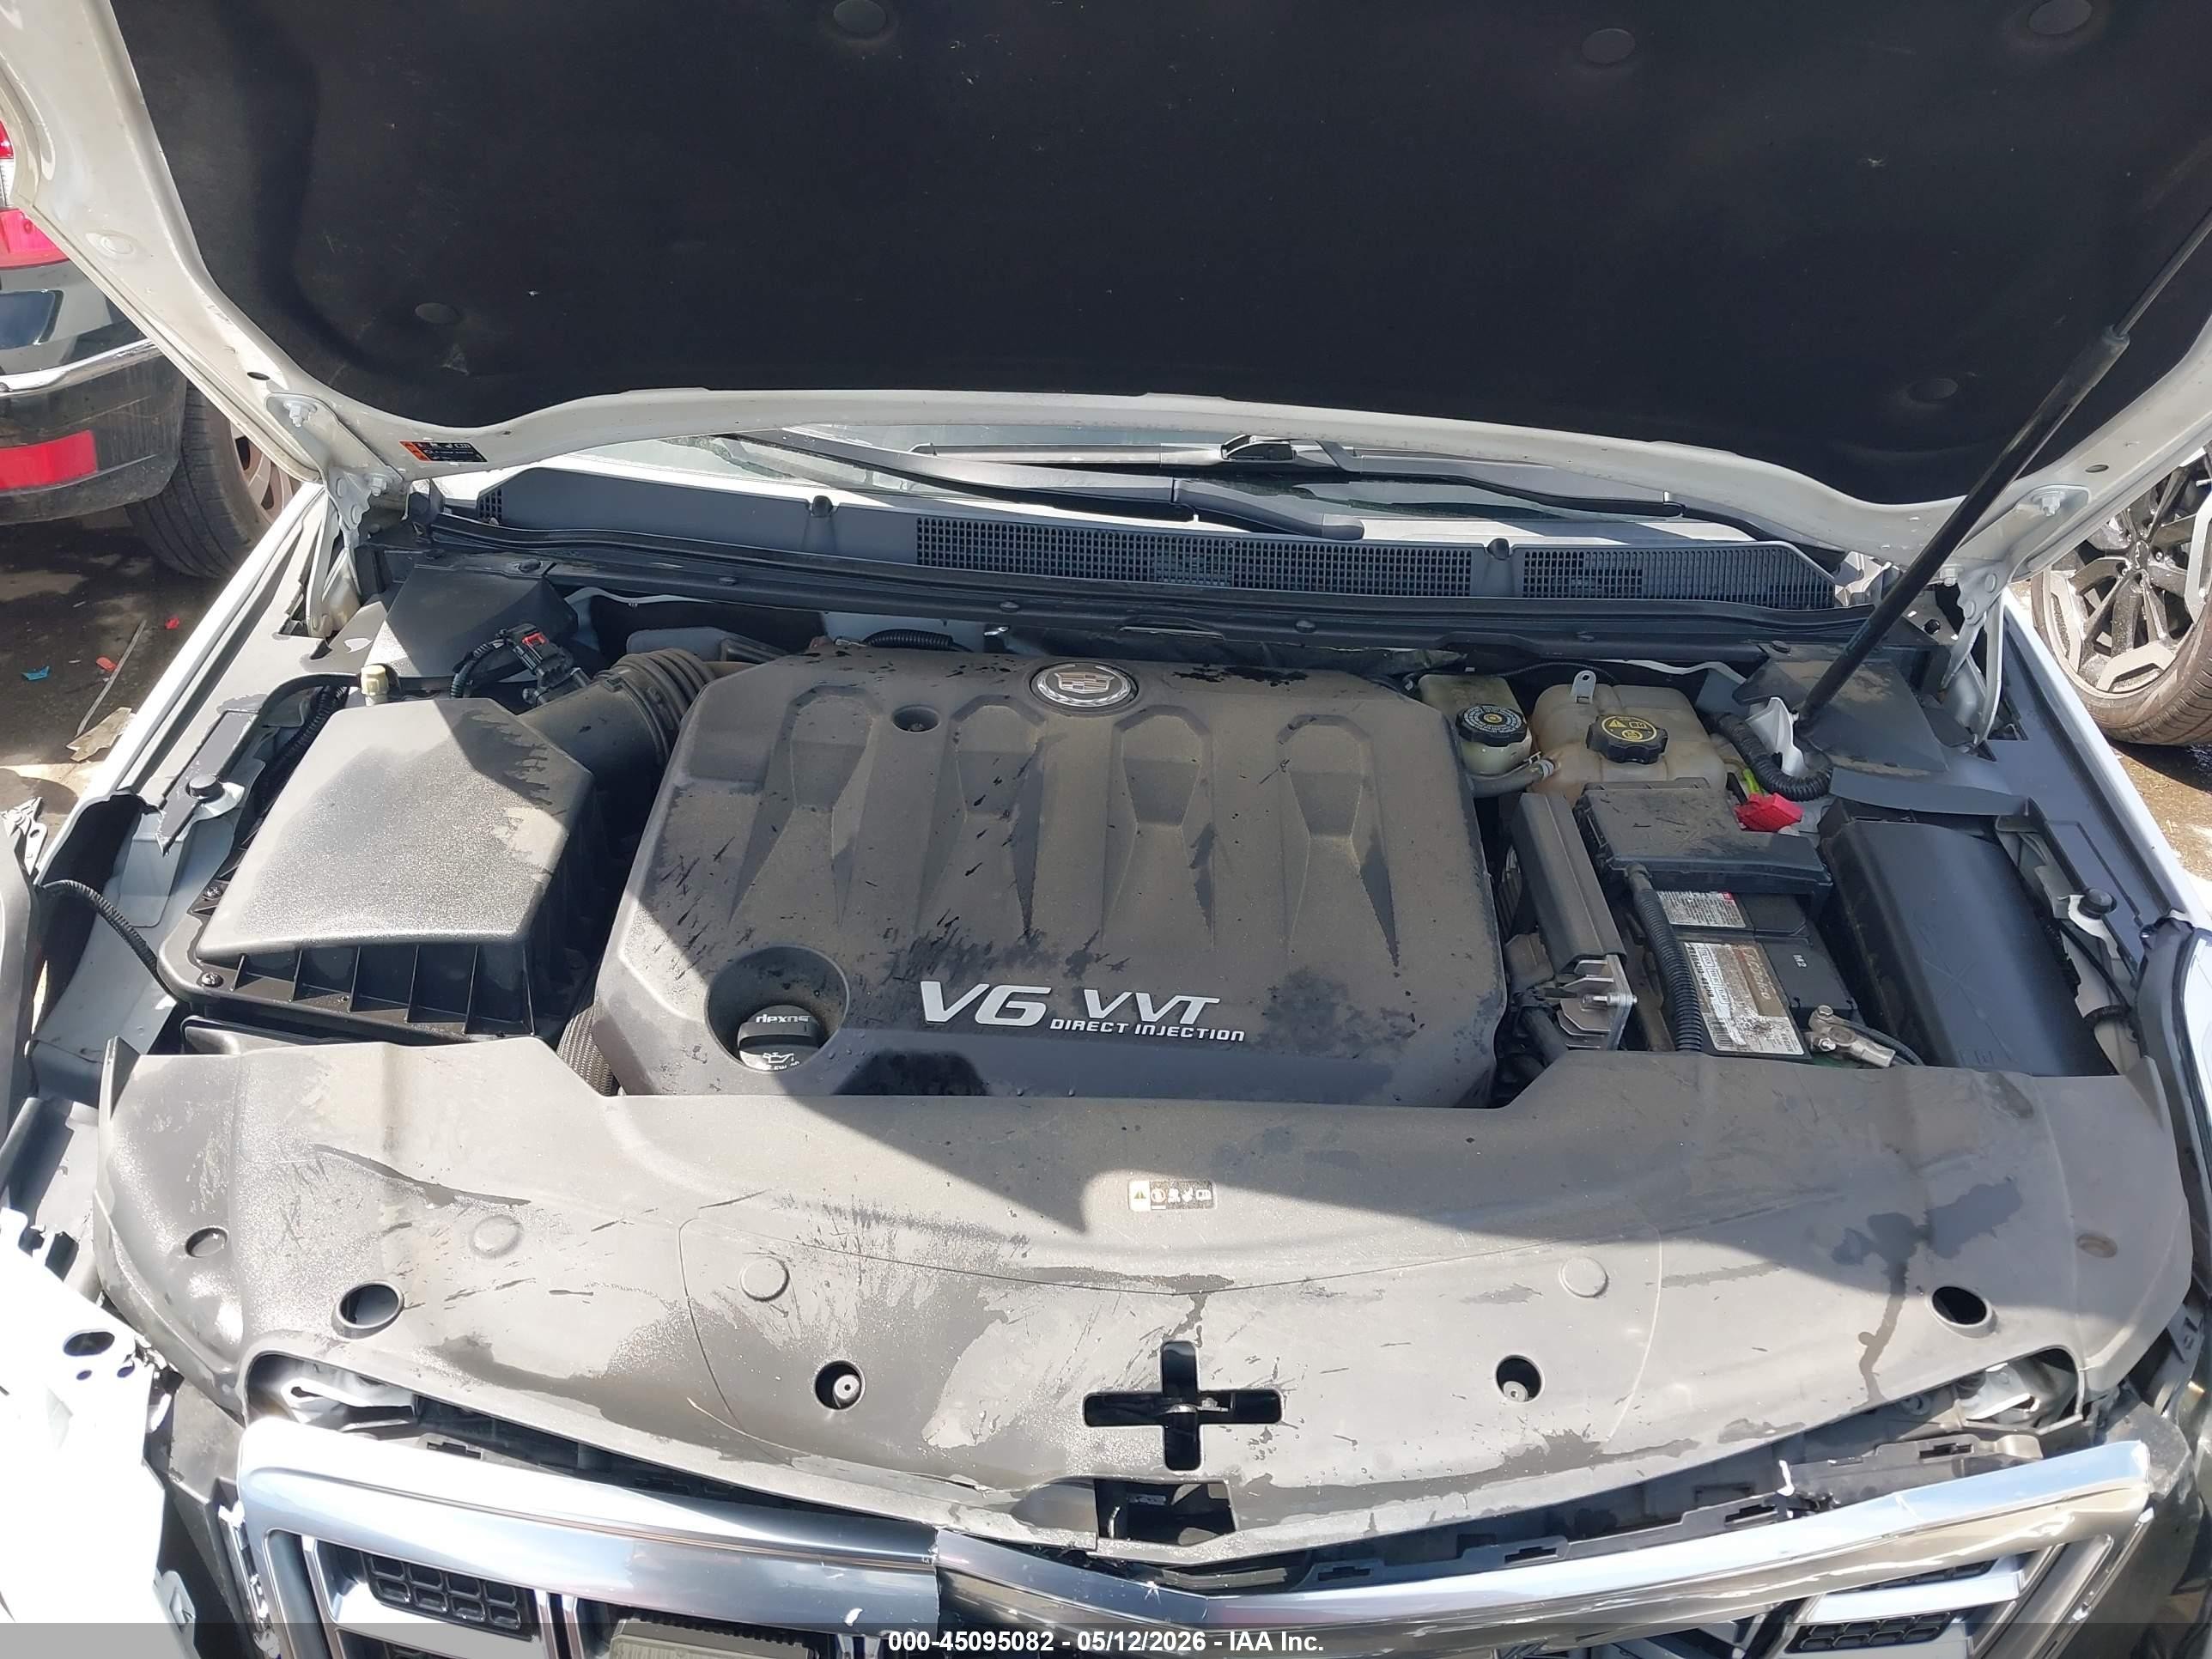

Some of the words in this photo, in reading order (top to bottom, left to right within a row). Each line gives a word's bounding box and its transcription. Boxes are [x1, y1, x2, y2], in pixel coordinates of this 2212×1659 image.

[1792, 954, 1808, 968] M2
[921, 981, 1052, 1026] V6
[1083, 989, 1220, 1024] VVT
[755, 1013, 811, 1024] dexos
[1049, 1018, 1129, 1035] DIRECT
[1134, 1024, 1246, 1042] INJECTION
